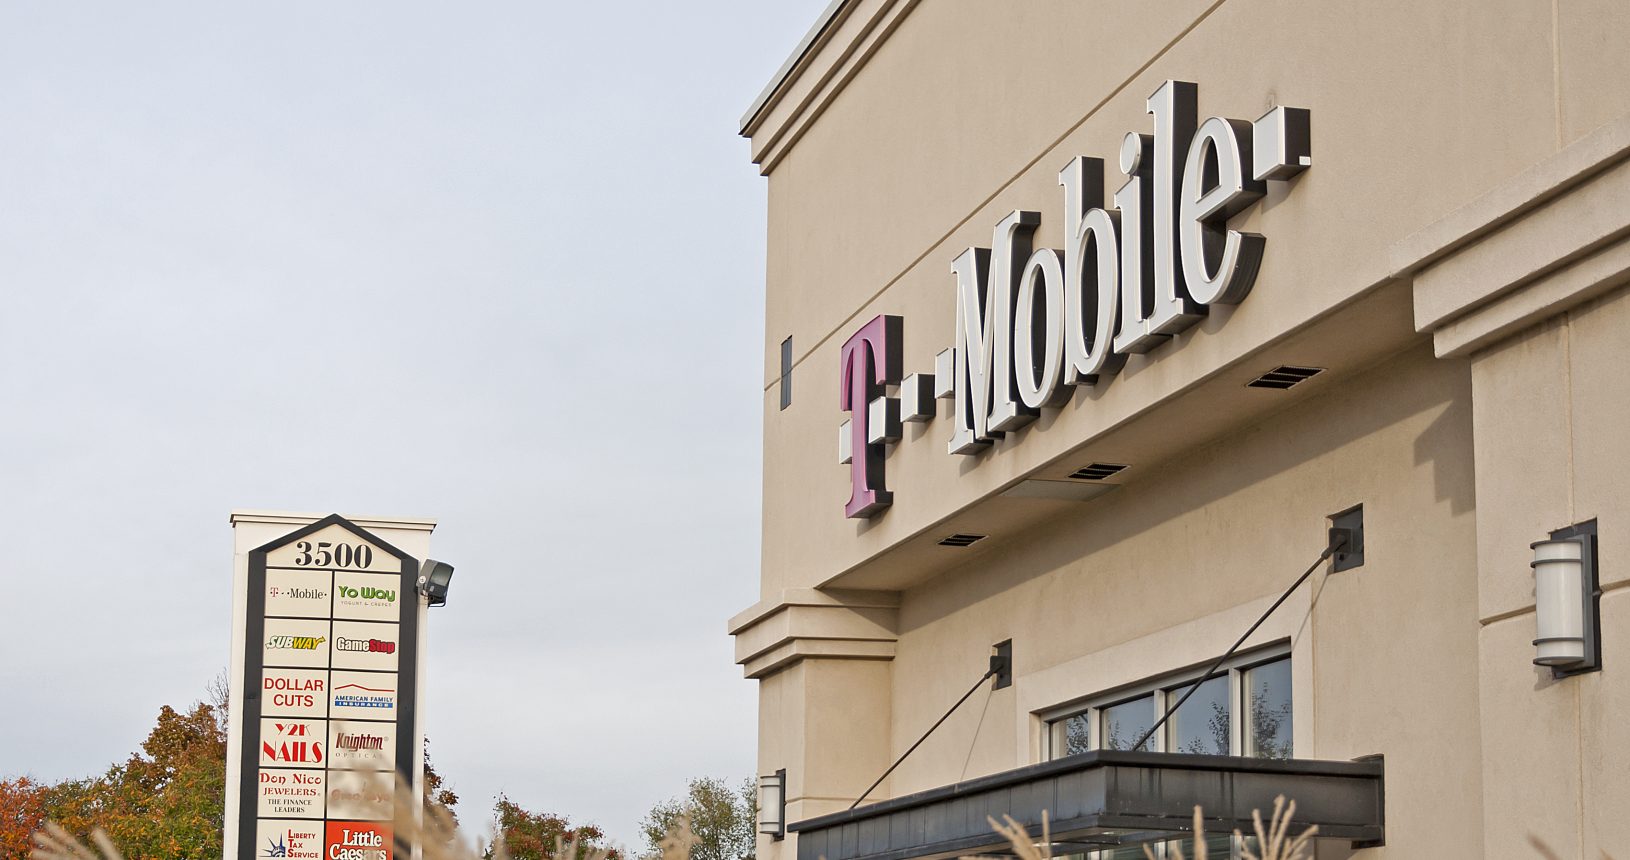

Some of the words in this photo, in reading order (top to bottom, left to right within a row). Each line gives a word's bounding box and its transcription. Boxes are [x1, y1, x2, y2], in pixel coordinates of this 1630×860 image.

[295, 541, 373, 569] 3500
[338, 585, 358, 599] Yo
[361, 586, 396, 603] Way
[265, 635, 326, 651] SUBWAY
[336, 637, 396, 655] GameStop
[264, 677, 324, 691] DOLLAR
[273, 694, 314, 707] CUTS
[275, 723, 311, 736] Y2K
[335, 732, 383, 752] Knighton
[263, 741, 323, 763] NAILS
[260, 772, 287, 785] Don
[292, 773, 322, 785] Nico
[263, 787, 317, 796] JEWELERS
[342, 829, 383, 847] Little
